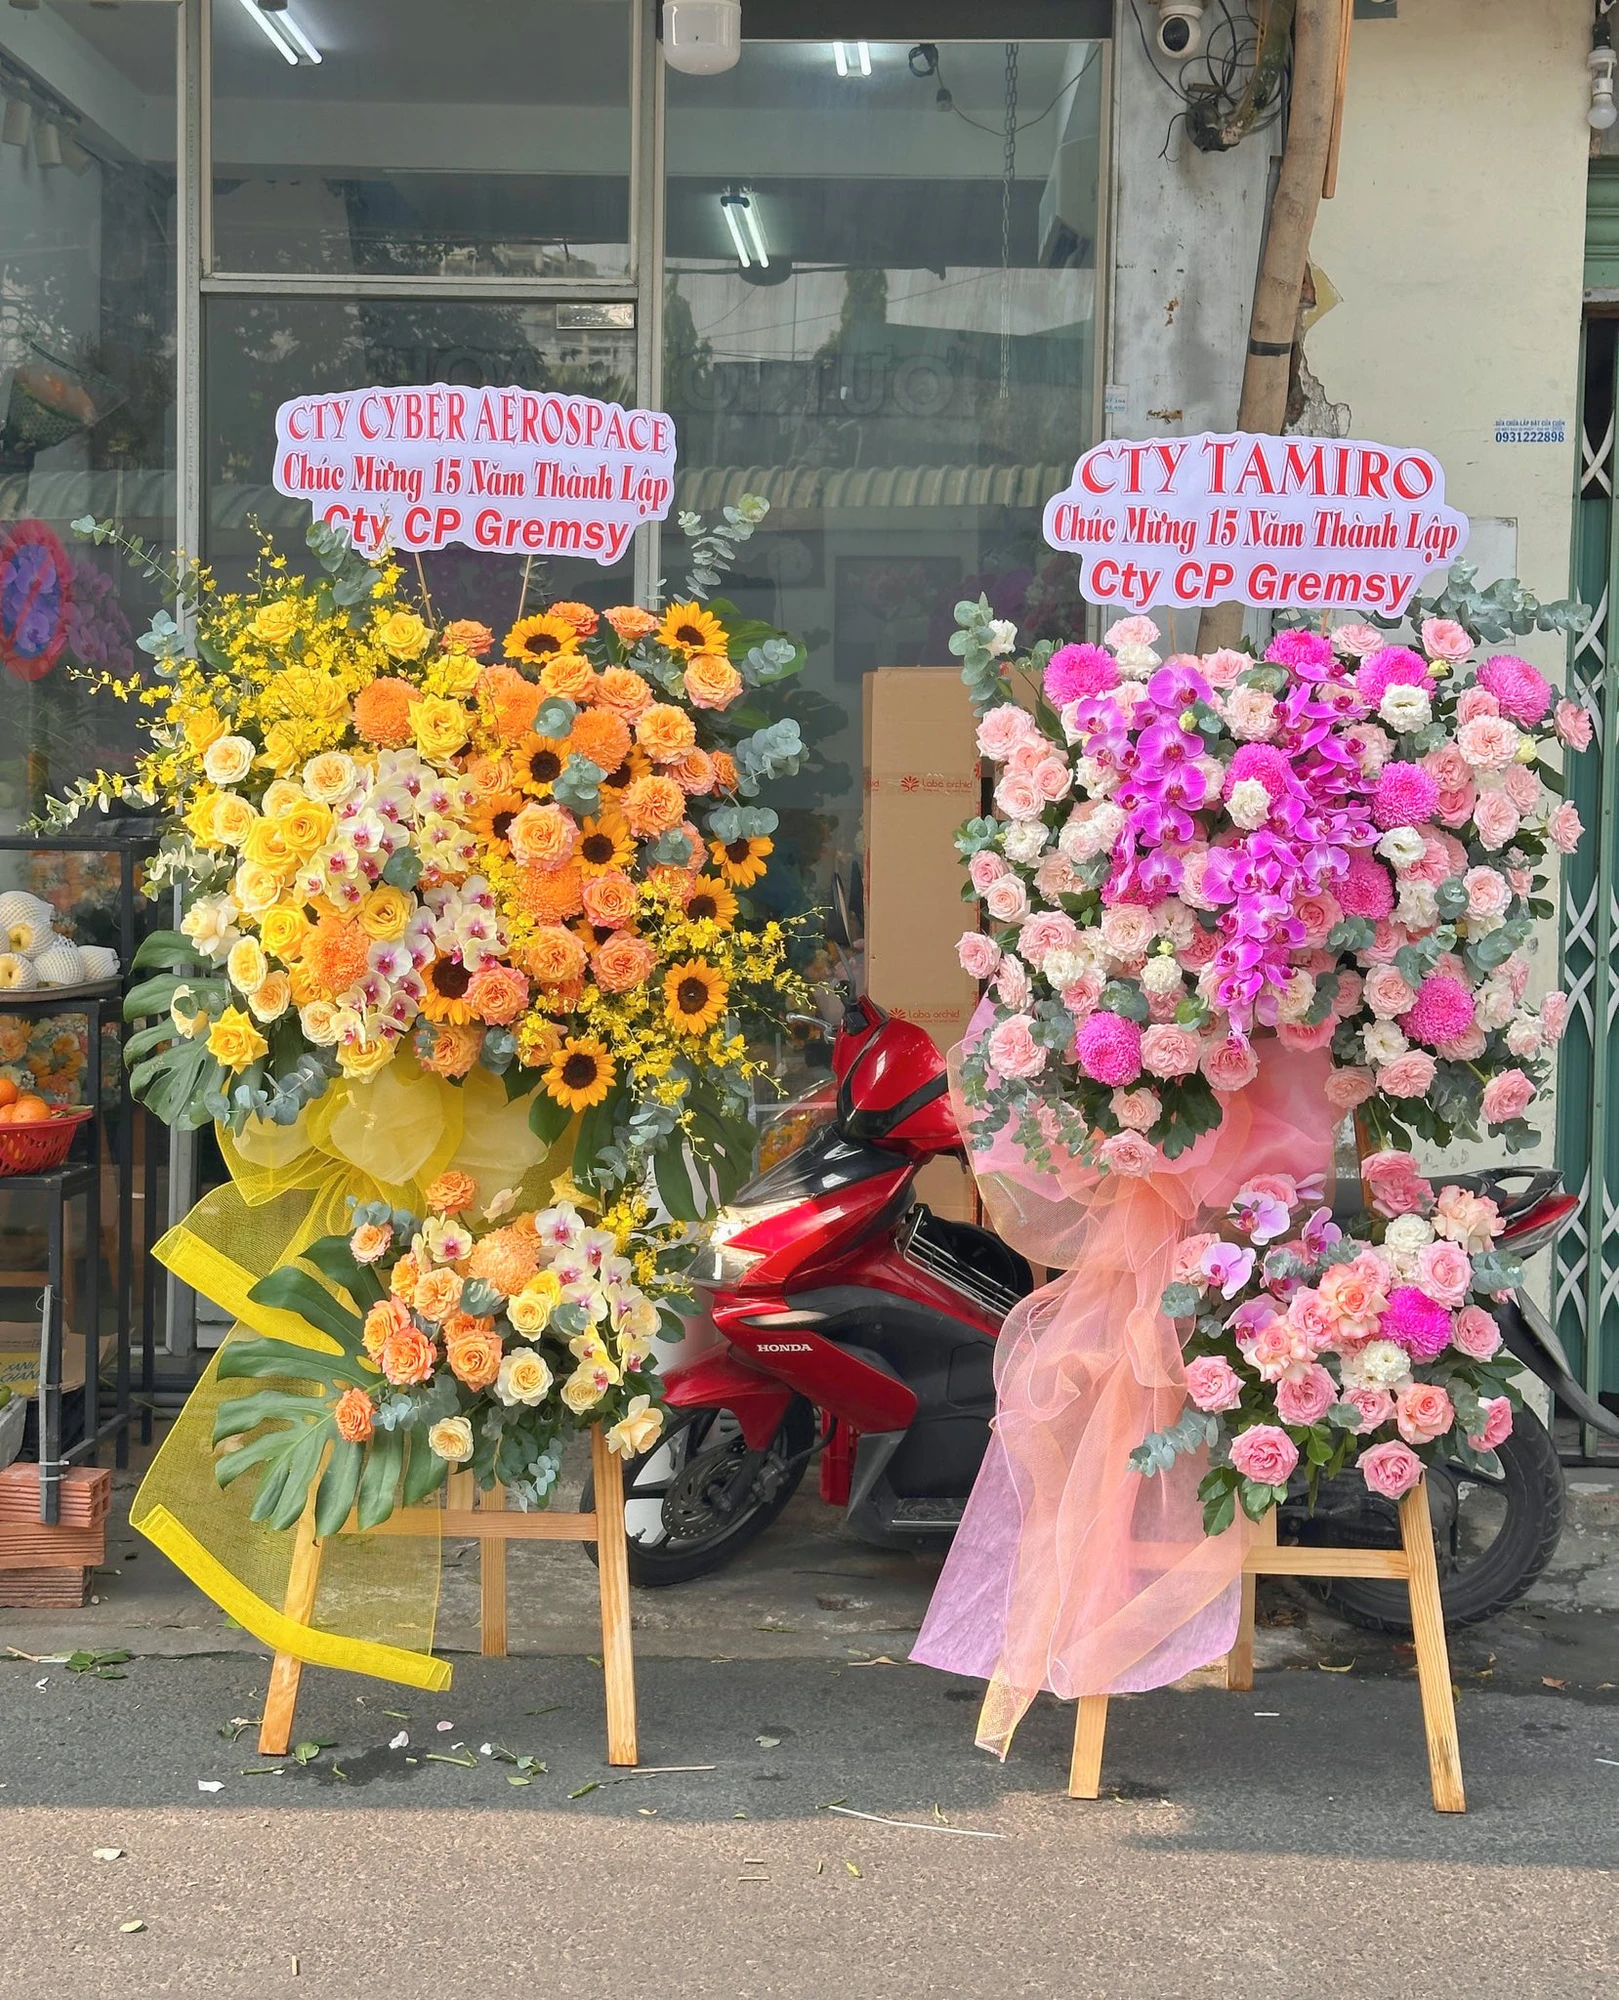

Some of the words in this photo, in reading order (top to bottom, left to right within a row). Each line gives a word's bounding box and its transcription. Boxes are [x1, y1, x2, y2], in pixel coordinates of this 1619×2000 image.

[288, 399, 351, 440] CTY
[357, 391, 466, 441] CYBER
[473, 391, 672, 455] AEROSPACE
[1495, 431, 1565, 443] 0931222898
[283, 451, 345, 491] Chúc
[352, 453, 423, 504] Mừng
[431, 458, 463, 495] 15
[468, 459, 526, 498] Năm
[533, 459, 613, 501] Thành
[620, 465, 669, 516] Lập
[1081, 443, 1188, 495] CTY
[1203, 440, 1434, 500] TAMIRO
[323, 504, 390, 549] Cty
[404, 507, 462, 545] CP
[474, 507, 629, 560] Gremsy
[1054, 504, 1116, 543] Chúc
[1124, 507, 1198, 555] Mừng
[1205, 509, 1238, 547] 15
[1243, 509, 1304, 548] Năm
[1313, 510, 1398, 550] Thành
[1406, 512, 1459, 564] Lập
[1091, 560, 1161, 607] Cty
[1174, 564, 1235, 599] CP
[1248, 563, 1413, 612] Gremsy
[0, 1369, 41, 1383] CHAN
[757, 1344, 814, 1353] HONDA
